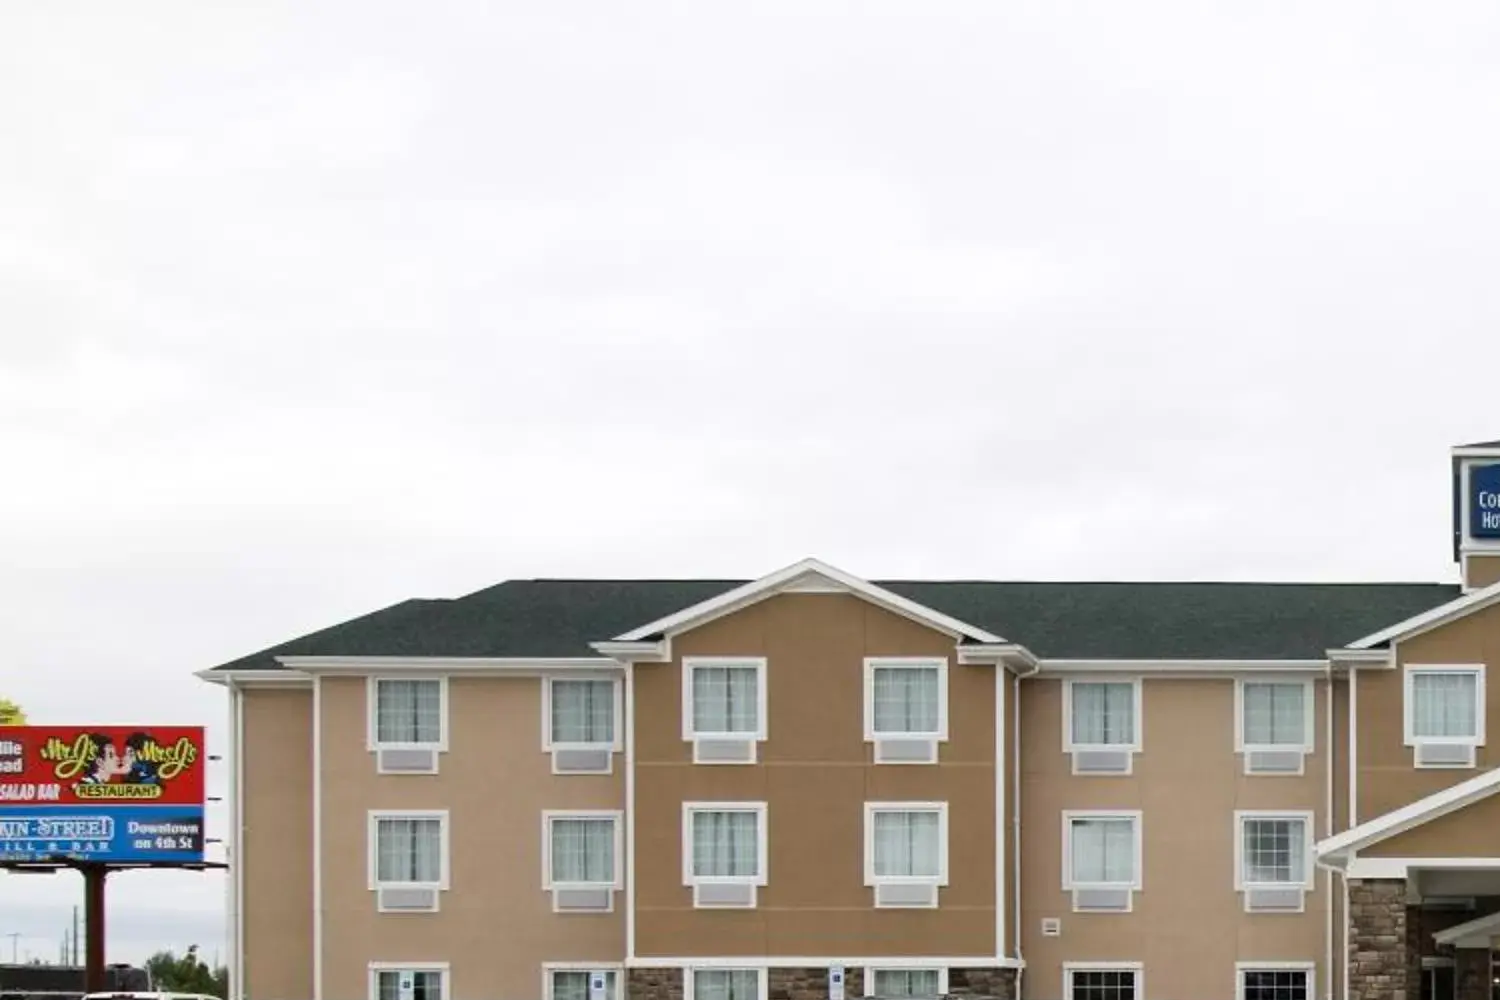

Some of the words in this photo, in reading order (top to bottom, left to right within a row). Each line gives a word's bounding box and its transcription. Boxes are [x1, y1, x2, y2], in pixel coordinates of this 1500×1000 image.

[37, 783, 61, 800] BAR
[79, 785, 157, 798] RESTAURANT
[127, 821, 199, 835] Downtown
[71, 841, 110, 852] BAR
[134, 838, 151, 849] on
[155, 836, 177, 849] 4th
[179, 835, 193, 849] St
